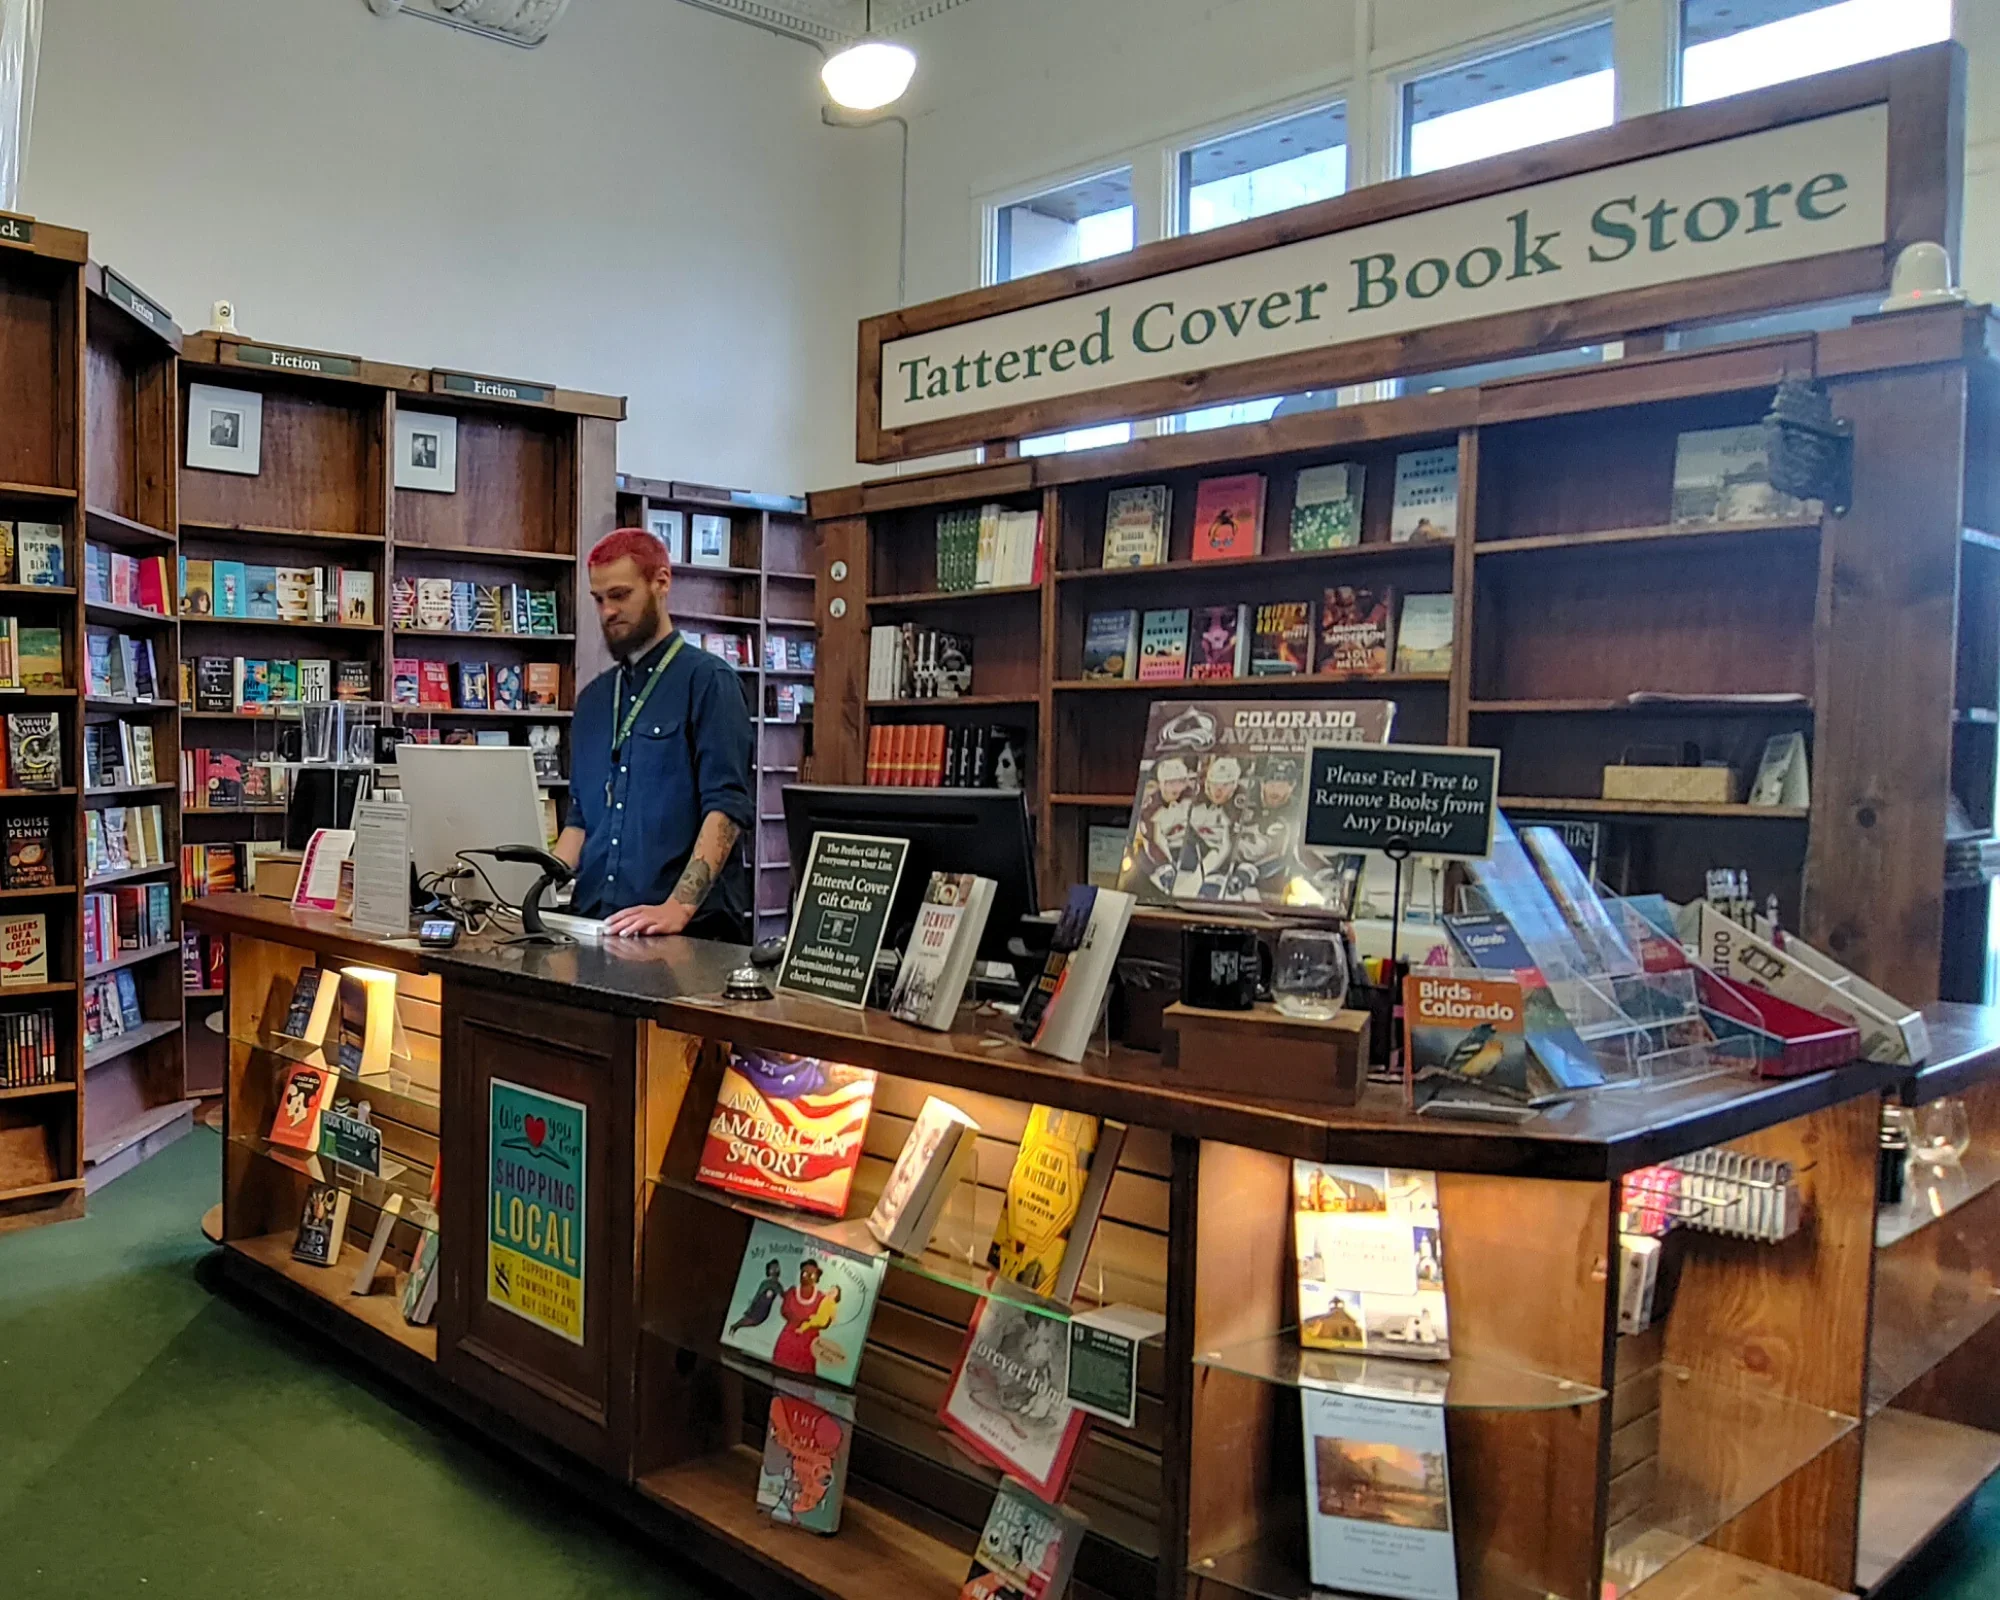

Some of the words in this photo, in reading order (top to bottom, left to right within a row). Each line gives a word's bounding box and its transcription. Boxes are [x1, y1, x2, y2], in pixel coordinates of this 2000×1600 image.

[899, 307, 1114, 403] Tattered
[1132, 281, 1327, 353] Cover
[1348, 209, 1562, 313] Book
[1588, 172, 1848, 263] Store
[271, 351, 320, 371] Fiction
[473, 380, 517, 398] Fiction
[301, 666, 320, 685] THE
[1235, 711, 1356, 728] COLORADO
[1220, 727, 1365, 744] AVALANCHE
[1326, 765, 1377, 785] Please
[1382, 769, 1416, 788] Feel
[1421, 772, 1457, 790] Free
[1462, 774, 1479, 791] to
[1316, 789, 1383, 809] Remove
[1388, 792, 1439, 812] Books
[1441, 794, 1484, 817] from
[6, 817, 50, 827] LOUISE
[1343, 813, 1381, 836] Any
[1385, 815, 1452, 840] Display
[9, 828, 49, 838] PENNY
[819, 854, 850, 867] Everyone
[827, 843, 840, 853] The
[841, 845, 864, 857] Perfect
[865, 847, 879, 858] Gift
[880, 848, 891, 859] for
[812, 872, 856, 891] Tattered
[857, 878, 890, 895] Cover
[818, 892, 839, 907] Gift
[840, 896, 872, 912] Cards
[5, 920, 38, 934] KILLERS
[923, 911, 956, 929] DENVER
[6, 937, 40, 950] CERTAIN
[12, 932, 22, 940] OF
[922, 930, 945, 947] FOOD
[16, 947, 31, 957] AGE
[802, 944, 835, 959] Available
[836, 950, 844, 961] in
[845, 954, 860, 966] any
[790, 955, 841, 975] denomination
[842, 968, 850, 977] at
[851, 966, 864, 980] the
[790, 969, 825, 986] check-out
[1420, 980, 1471, 1001] Birds
[1420, 1000, 1514, 1021] Colorado
[728, 1092, 760, 1114] AN
[323, 1114, 341, 1130] BOOK
[341, 1120, 352, 1134] TO
[352, 1123, 378, 1145] MOVIE
[500, 1104, 522, 1132] We
[548, 1118, 572, 1140] you
[714, 1111, 848, 1159] AMERICAN
[559, 1139, 580, 1157] for
[726, 1141, 809, 1178] STORY
[496, 1158, 576, 1211] SHOPPING
[495, 1191, 576, 1267] LOCAL
[522, 1258, 553, 1283] SUPPORT
[556, 1273, 570, 1292] OUR
[751, 1246, 766, 1260] My
[769, 1243, 804, 1255] Mother
[840, 1262, 868, 1294] Nanny
[516, 1274, 558, 1304] COMMUNITY
[561, 1294, 576, 1313] AND
[522, 1294, 536, 1310] BUY
[539, 1303, 569, 1327] LOCALLY
[1027, 1366, 1065, 1404] hom
